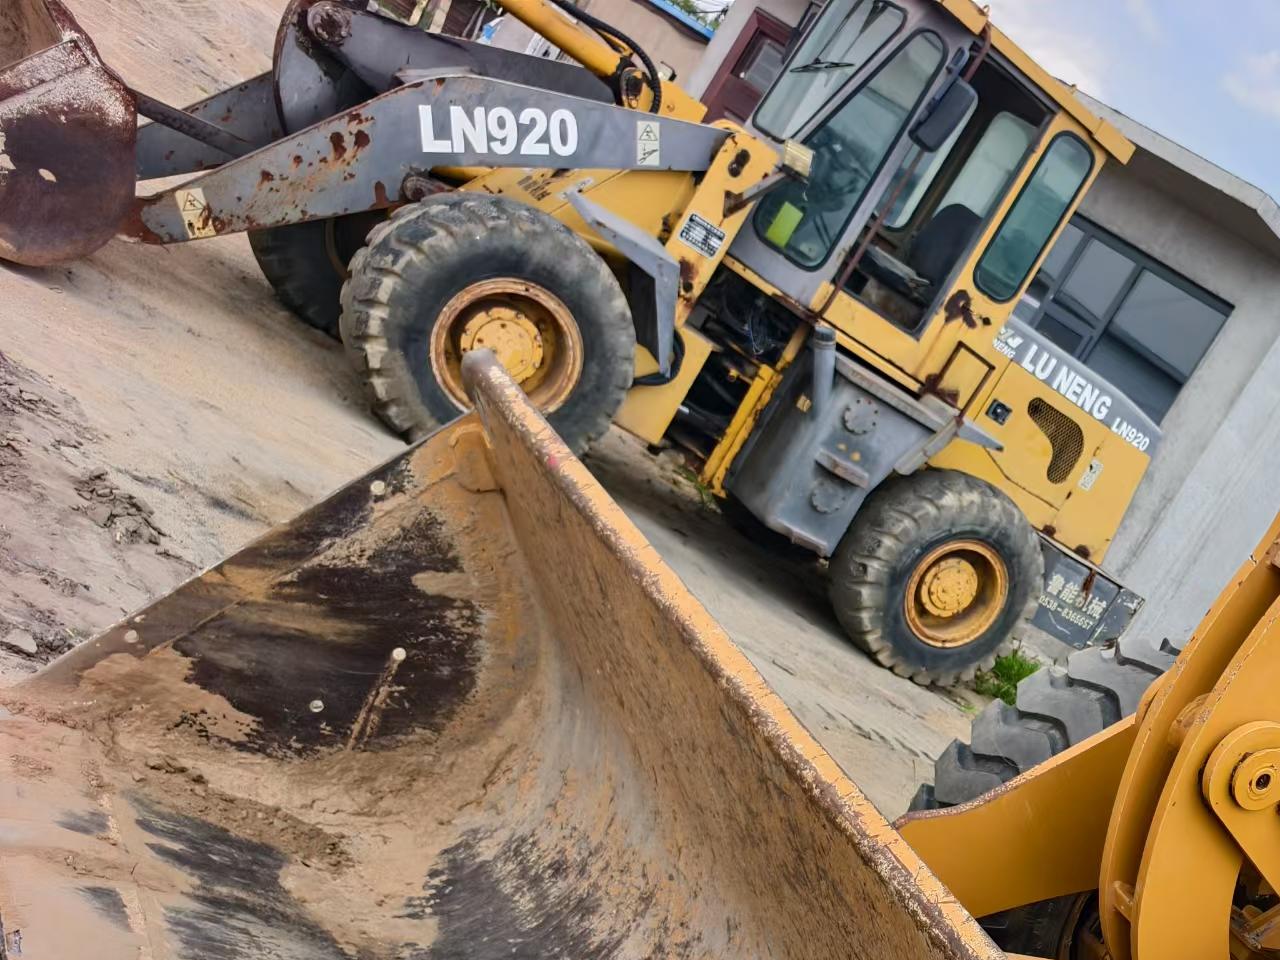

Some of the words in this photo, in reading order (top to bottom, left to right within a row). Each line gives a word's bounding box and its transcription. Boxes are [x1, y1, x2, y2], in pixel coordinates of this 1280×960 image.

[418, 105, 578, 156] LN920
[1021, 344, 1057, 380] LU
[1052, 365, 1112, 420] NENG
[1110, 417, 1150, 451] LN920
